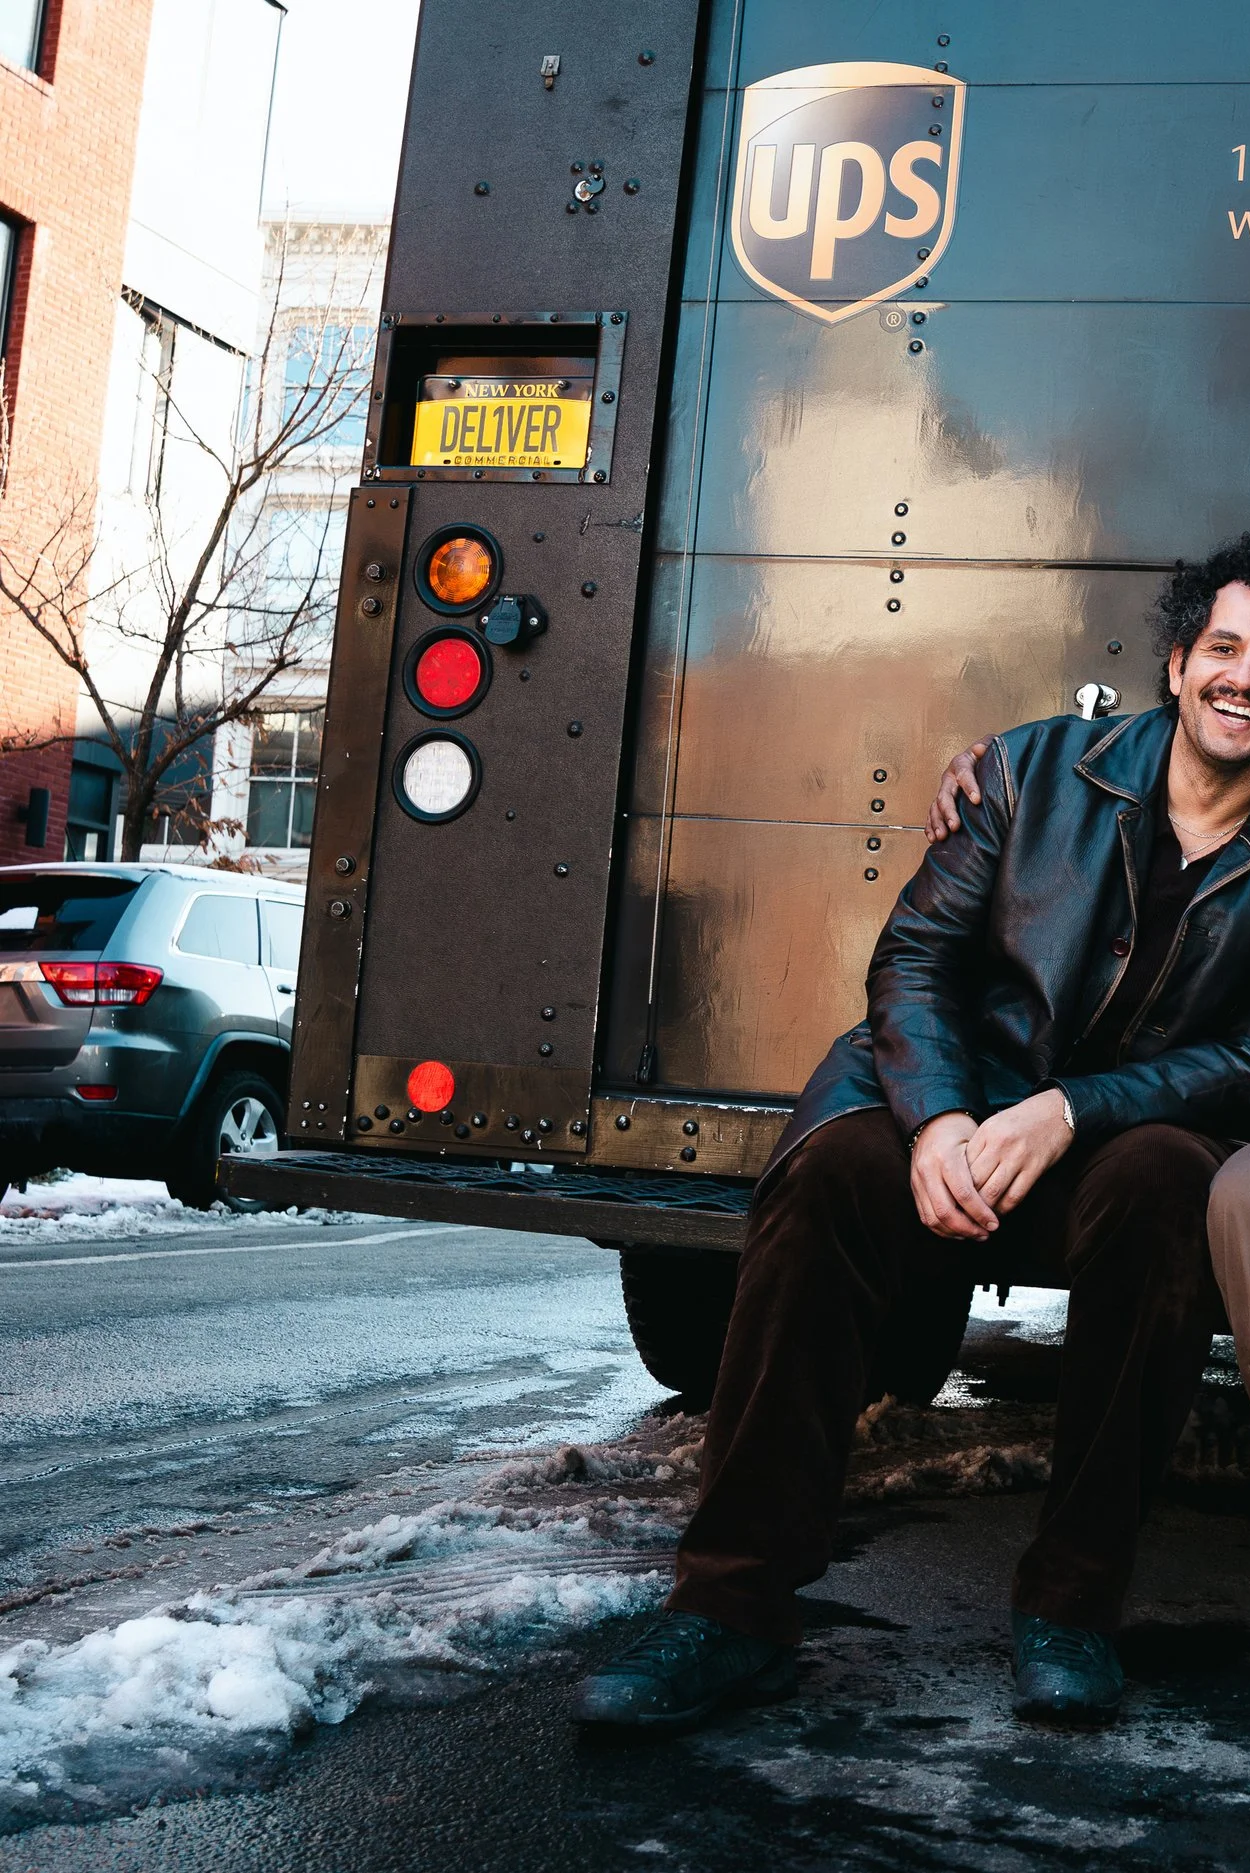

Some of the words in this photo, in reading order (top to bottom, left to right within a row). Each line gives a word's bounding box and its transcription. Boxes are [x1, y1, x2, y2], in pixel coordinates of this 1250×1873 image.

[748, 140, 943, 280] ups
[464, 383, 508, 398] NEW
[514, 383, 560, 398] YORK
[440, 404, 562, 453] DEL1VER
[454, 455, 551, 466] COMMERCIAL
